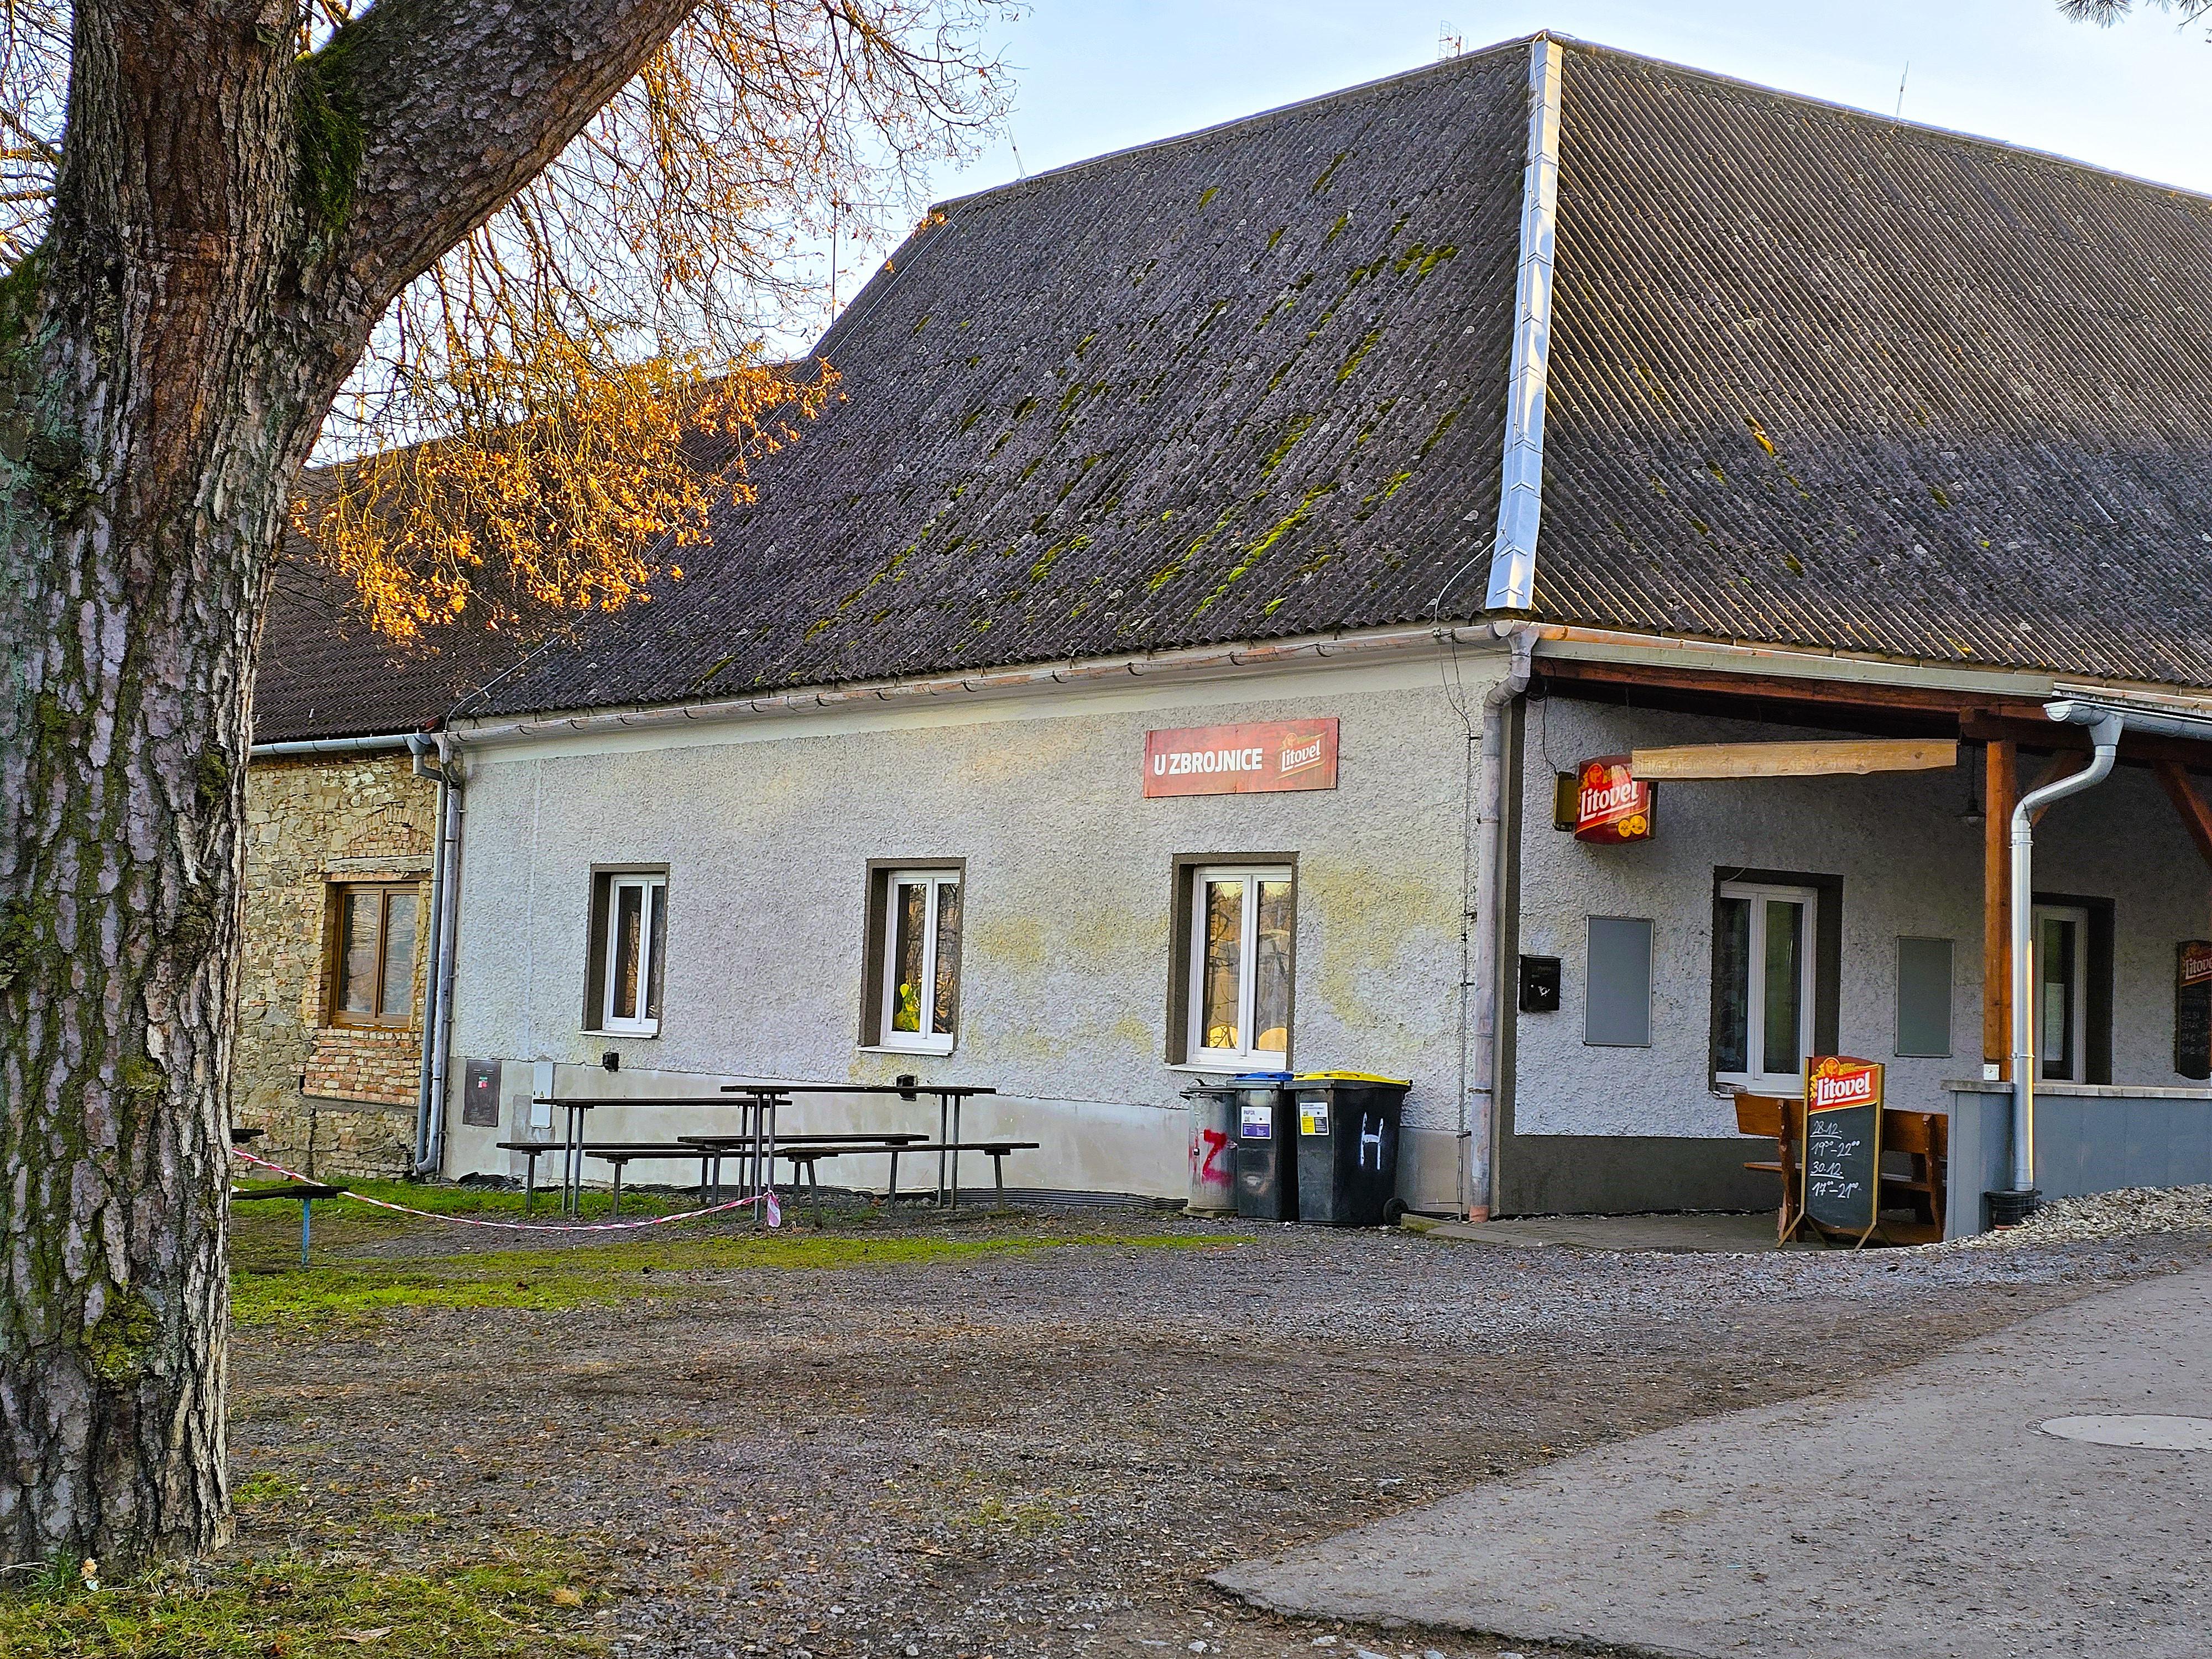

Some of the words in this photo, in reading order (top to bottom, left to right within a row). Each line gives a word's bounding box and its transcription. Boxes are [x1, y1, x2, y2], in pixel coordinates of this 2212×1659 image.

[1154, 754, 1166, 776] U
[1168, 748, 1263, 775] ZBROJNICE
[1281, 739, 1321, 773] Litovel
[1580, 781, 1640, 822] Litovel
[1817, 1072, 1871, 1106] Litovel
[1359, 1112, 1384, 1170] H
[1811, 1161, 1843, 1176] 30.12.
